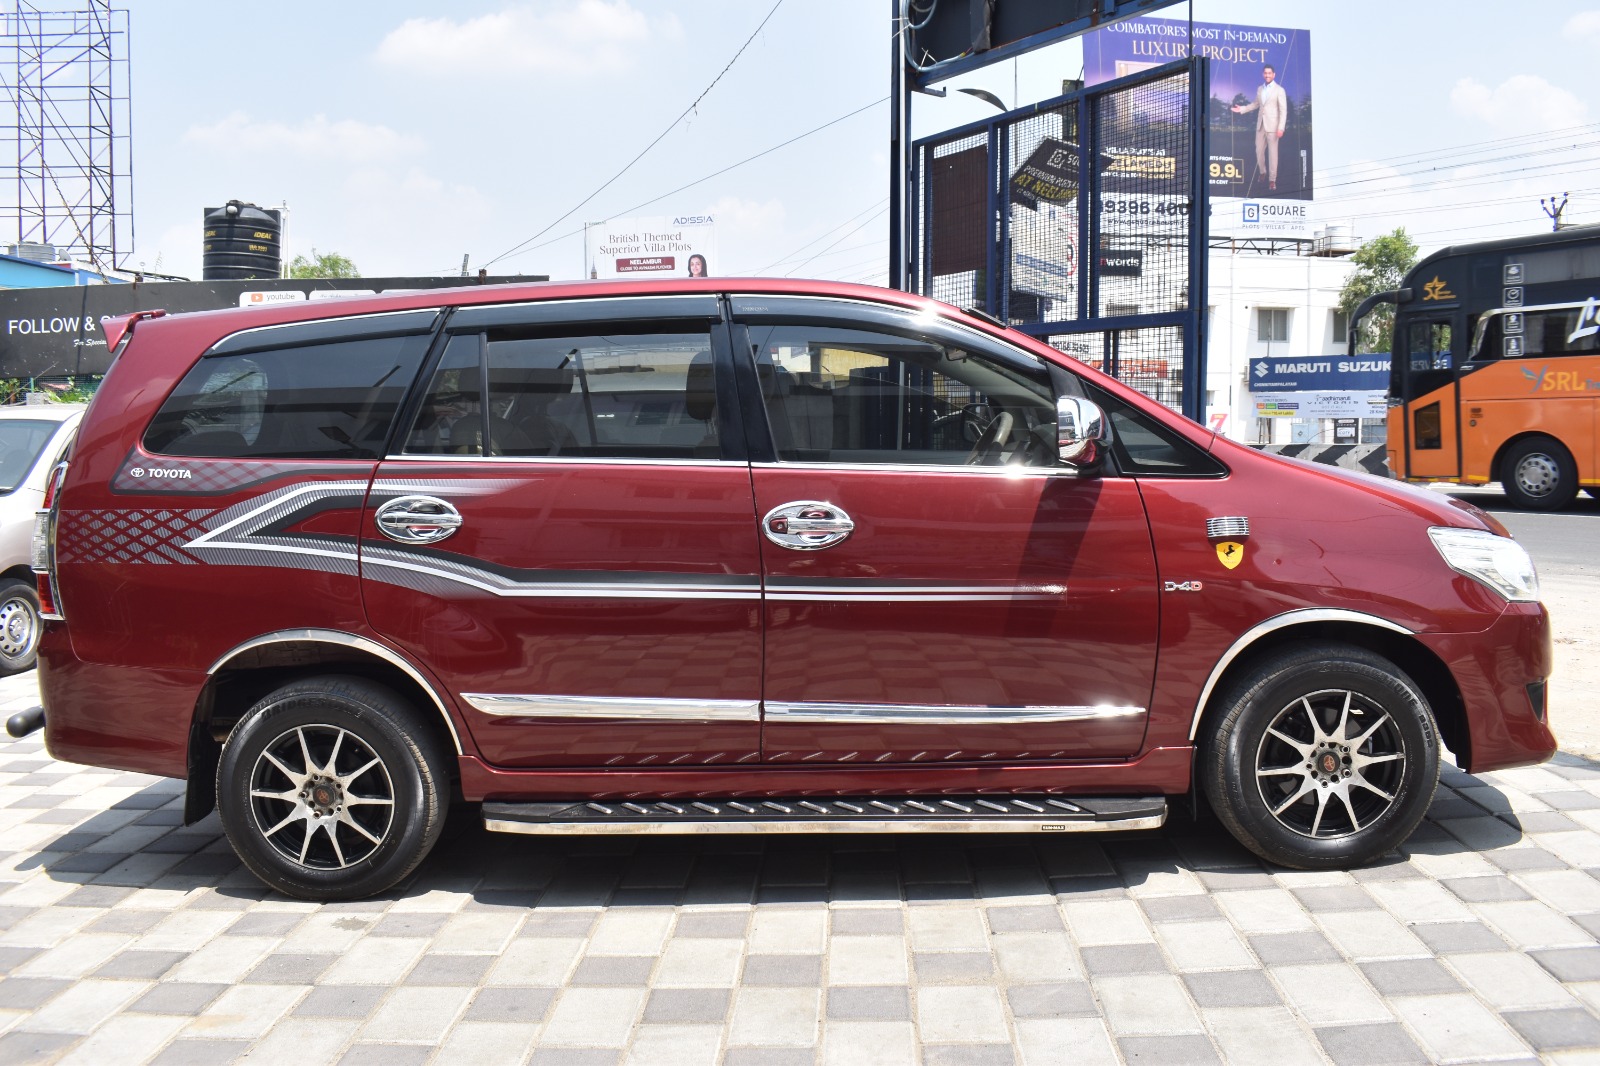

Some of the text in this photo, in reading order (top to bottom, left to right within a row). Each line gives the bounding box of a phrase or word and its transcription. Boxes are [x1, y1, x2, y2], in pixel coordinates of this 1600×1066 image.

[1107, 21, 1287, 44] COIMBATORE'S MOST IN-DEMAND
[1202, 45, 1269, 63] PROJECT
[1116, 158, 1172, 169] ELAMEDU
[1209, 163, 1242, 178] 9.9L
[1247, 204, 1306, 218] G SQUARE
[609, 232, 682, 244] British Themed
[599, 242, 692, 257] Superior Villa Plots
[266, 293, 295, 301] youtube
[8, 316, 96, 335] FOLLOW &
[1274, 362, 1331, 374] MARUTI
[1338, 361, 1392, 373] SUZUK
[1410, 359, 1449, 371] ERVCE
[1542, 371, 1586, 391] SRL
[148, 468, 192, 479] TOYOTA
